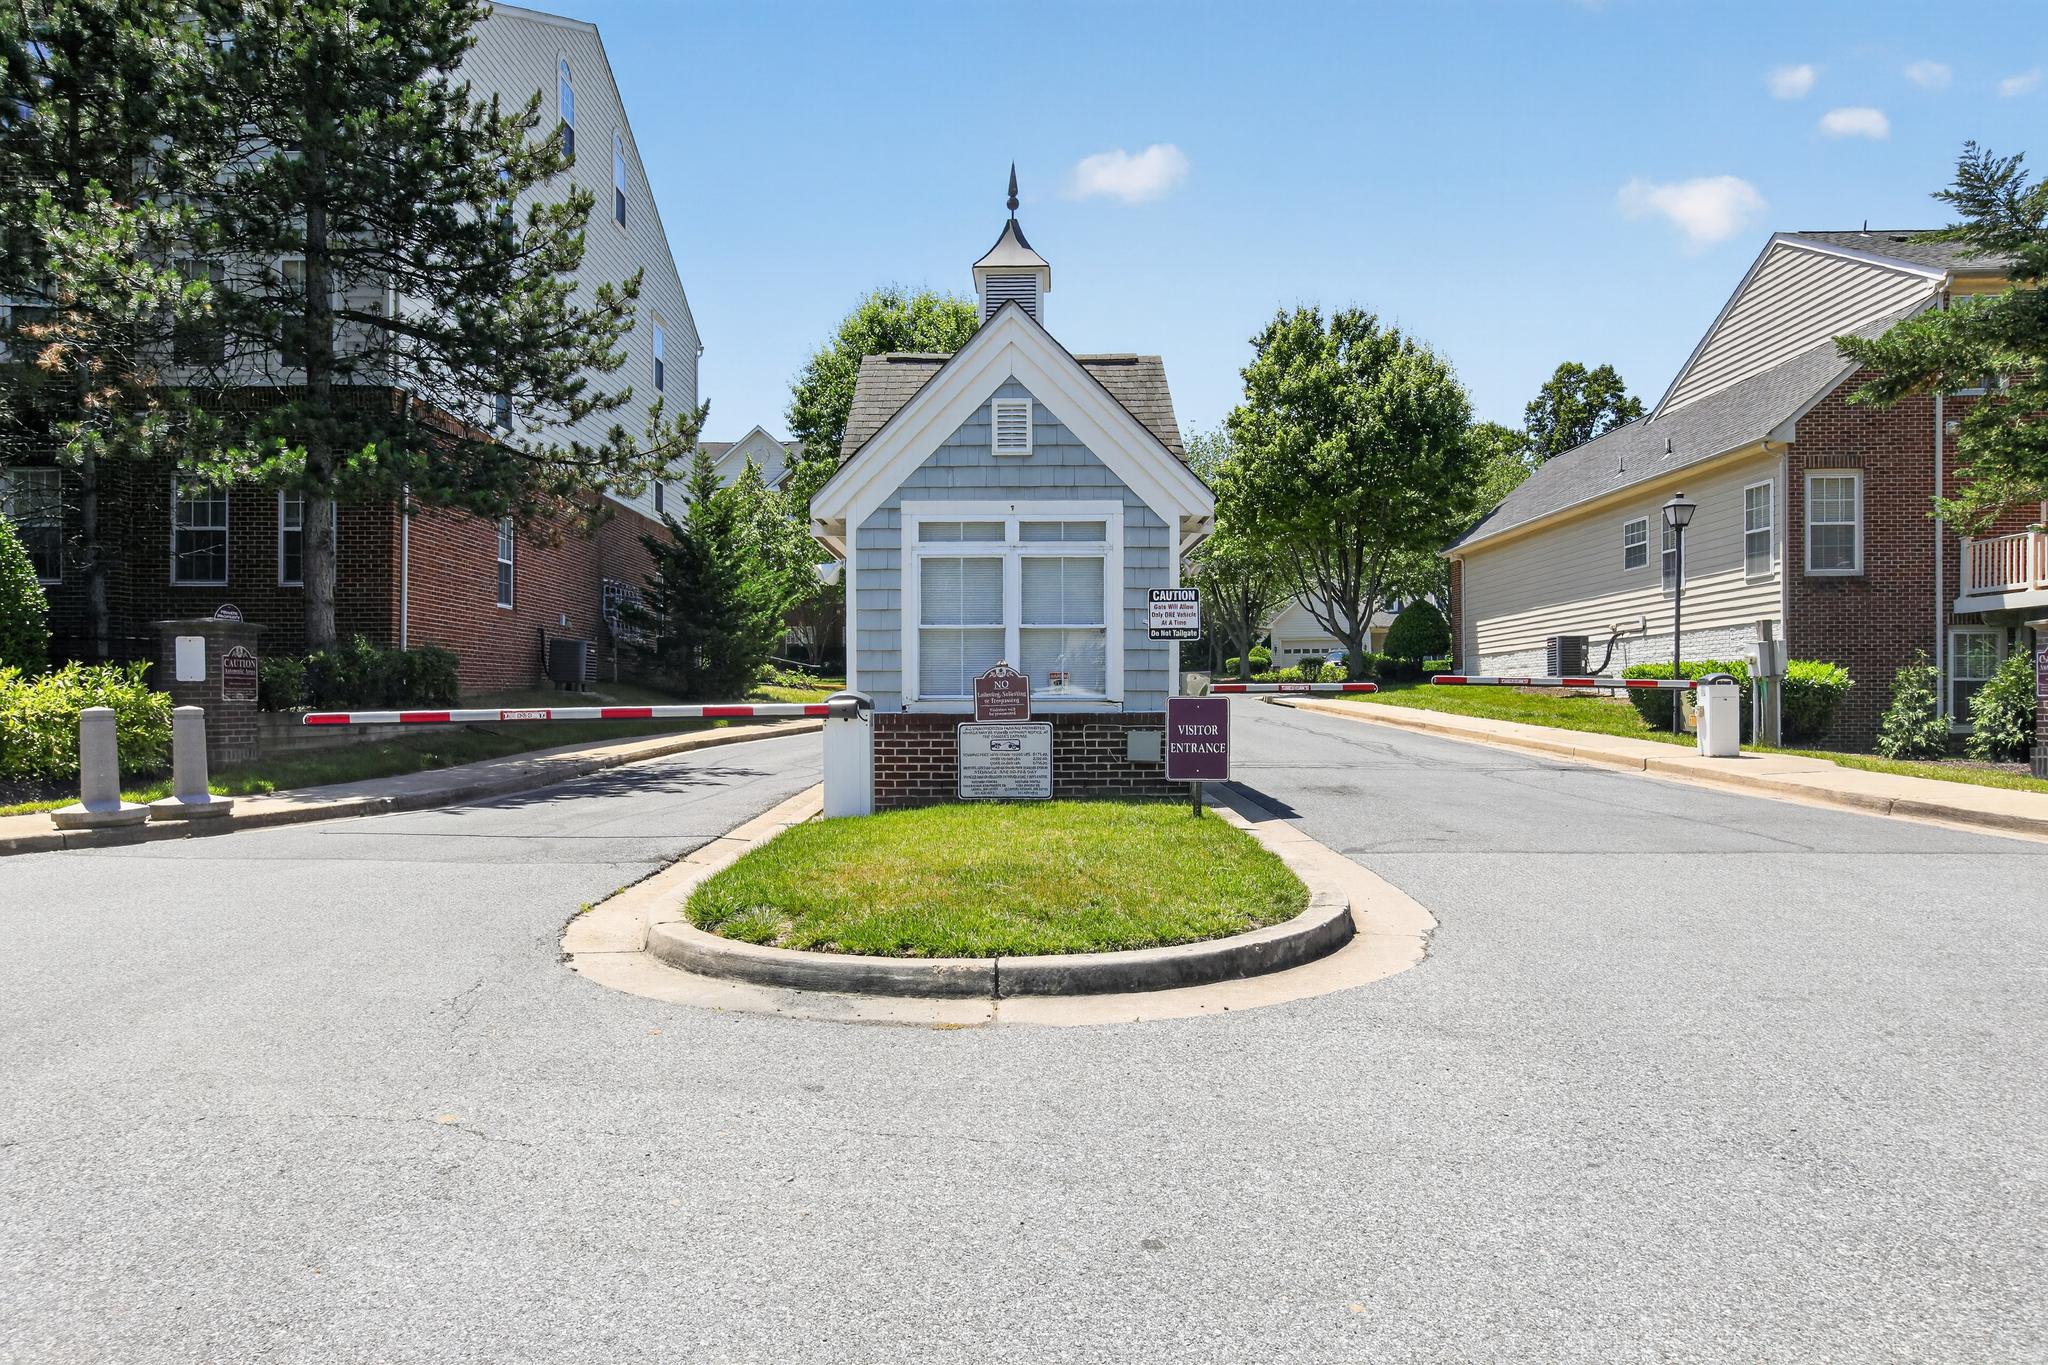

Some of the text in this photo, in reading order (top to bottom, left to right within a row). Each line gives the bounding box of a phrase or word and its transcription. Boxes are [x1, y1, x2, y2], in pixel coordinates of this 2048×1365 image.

[1152, 590, 1196, 600] CAUTION
[224, 659, 255, 668] CAUTION
[1178, 725, 1218, 736] VISITOR
[1170, 743, 1226, 753] ENTRANCE
